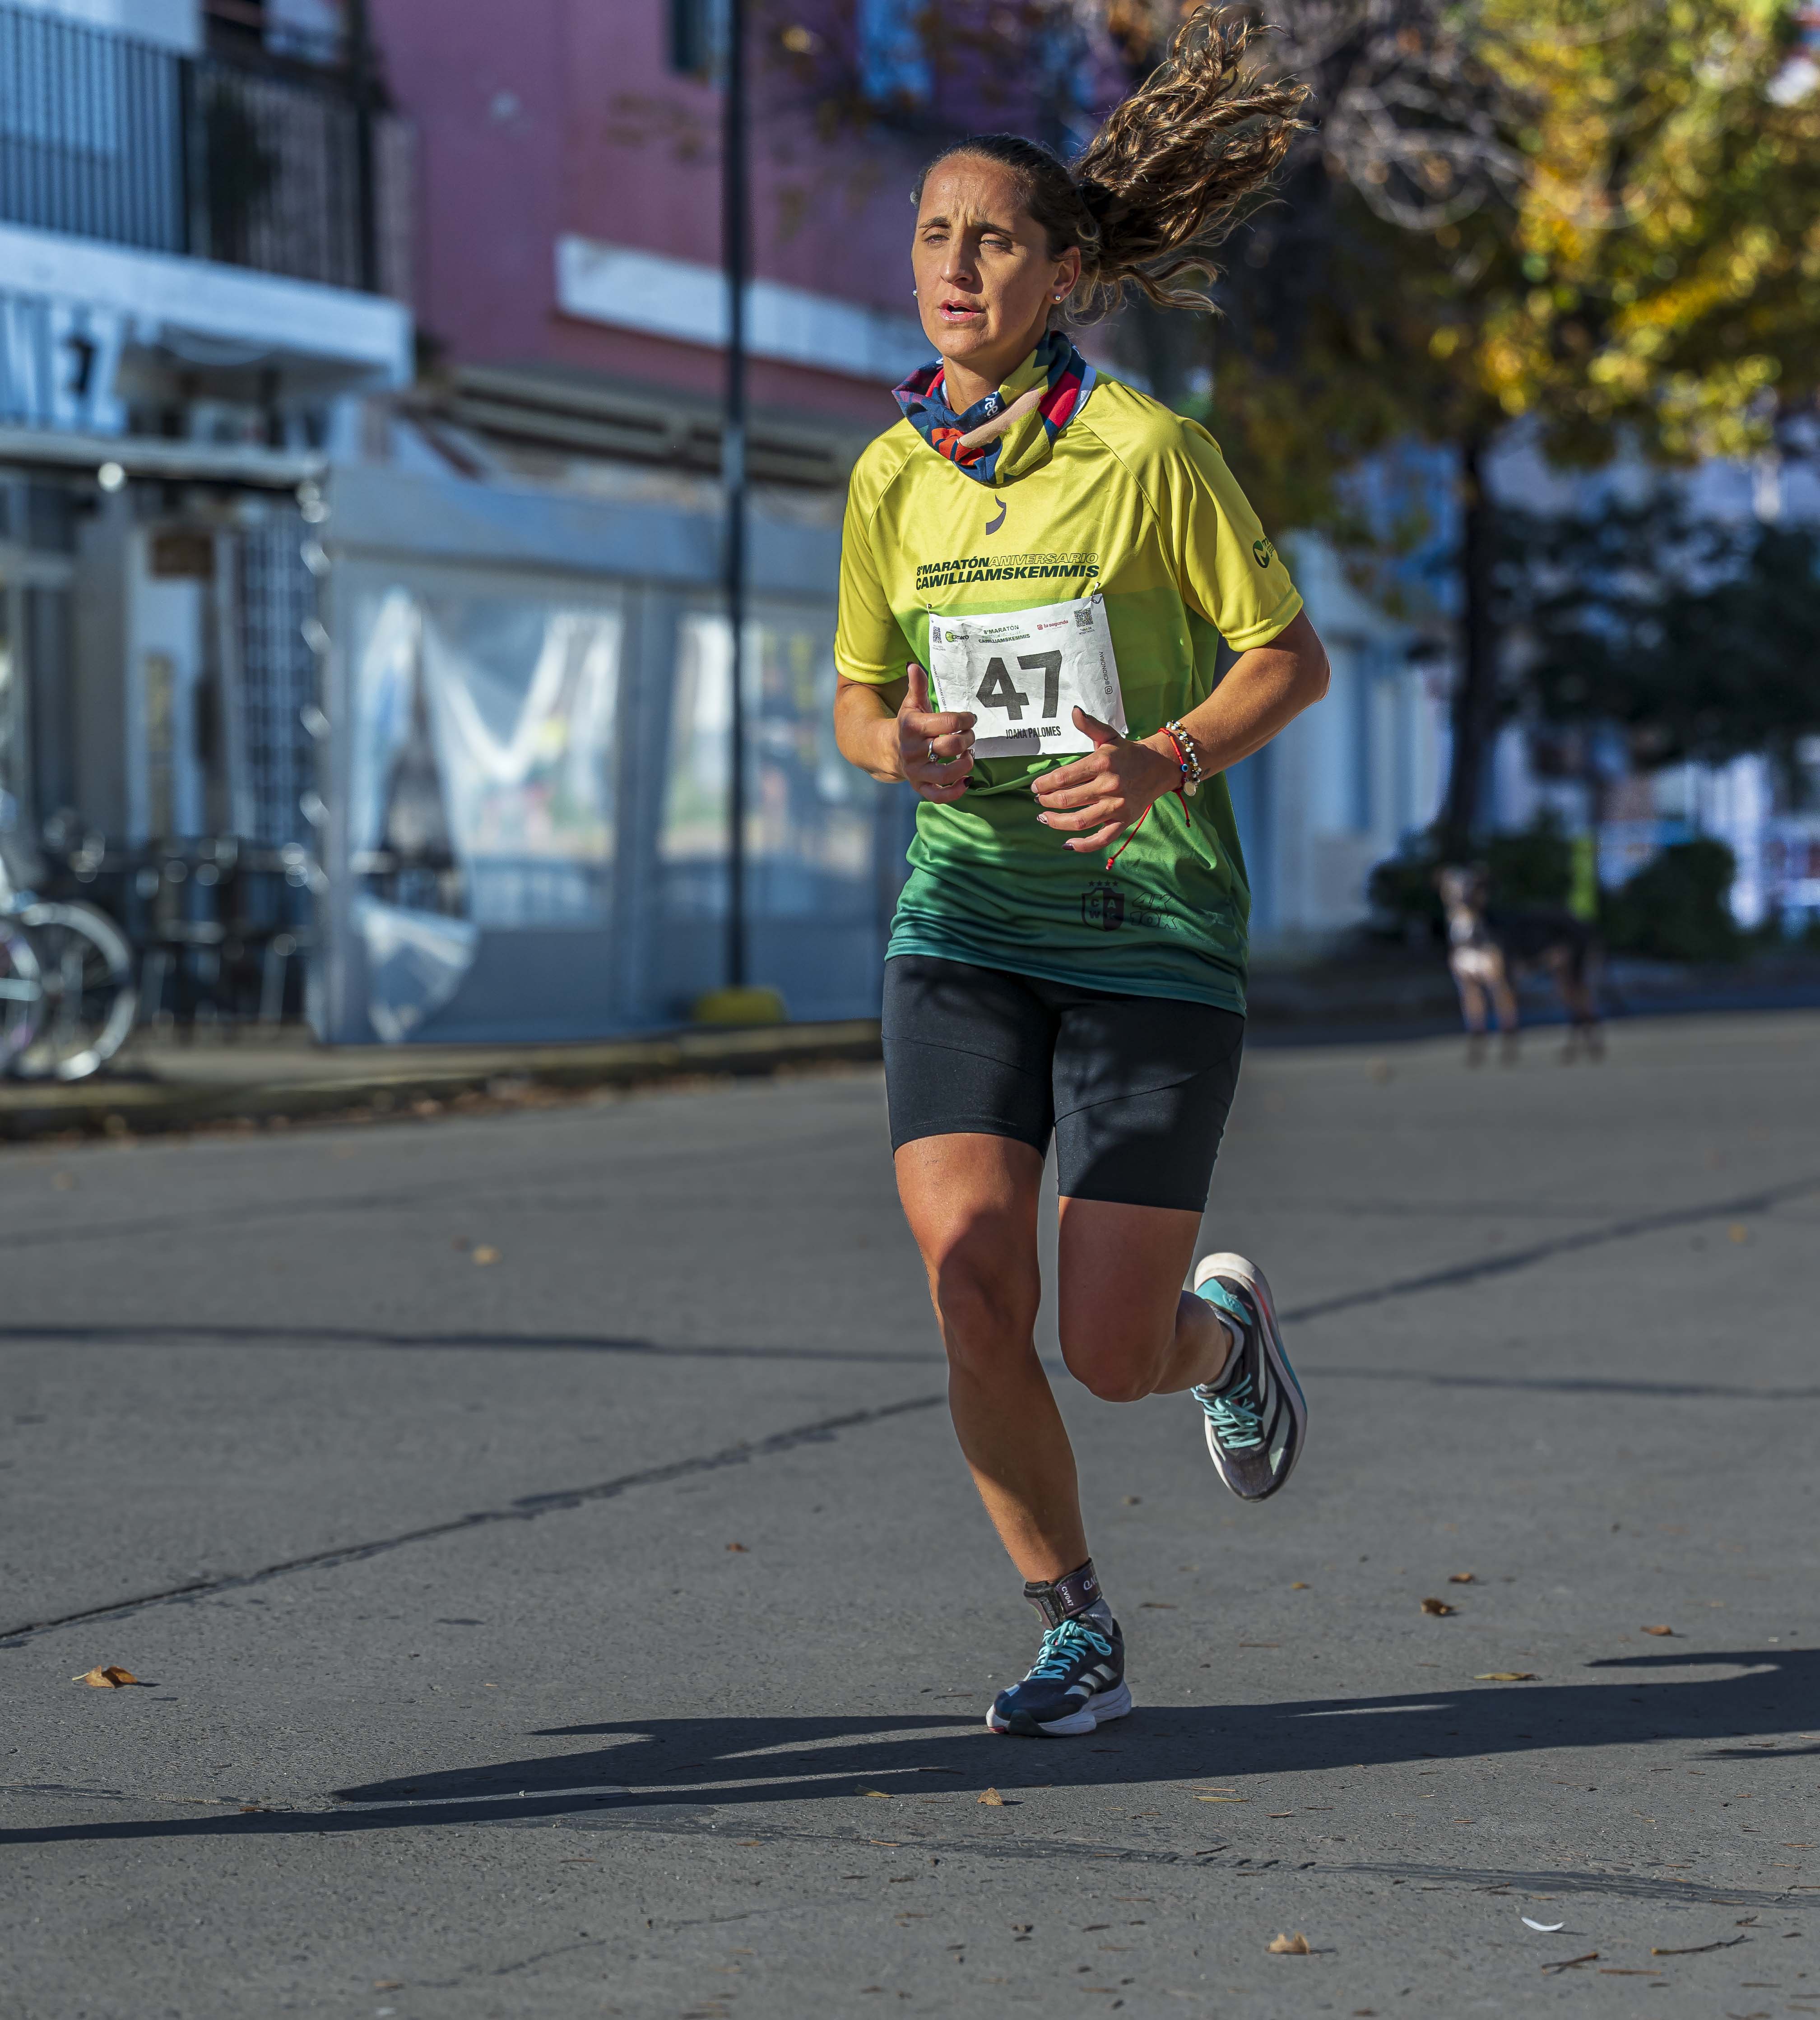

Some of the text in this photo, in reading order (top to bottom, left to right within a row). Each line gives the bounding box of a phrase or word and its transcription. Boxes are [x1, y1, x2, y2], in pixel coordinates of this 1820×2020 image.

[916, 565, 1100, 590] CAWILLIAMSKEMMIS
[978, 634, 1031, 643] CAWILLIAMSKEMMIS
[1098, 651, 1110, 685] @CRONORAV
[975, 649, 1063, 720] 47
[1006, 726, 1061, 739] JOANA PALOMES
[1061, 1586, 1074, 1607] CV047
